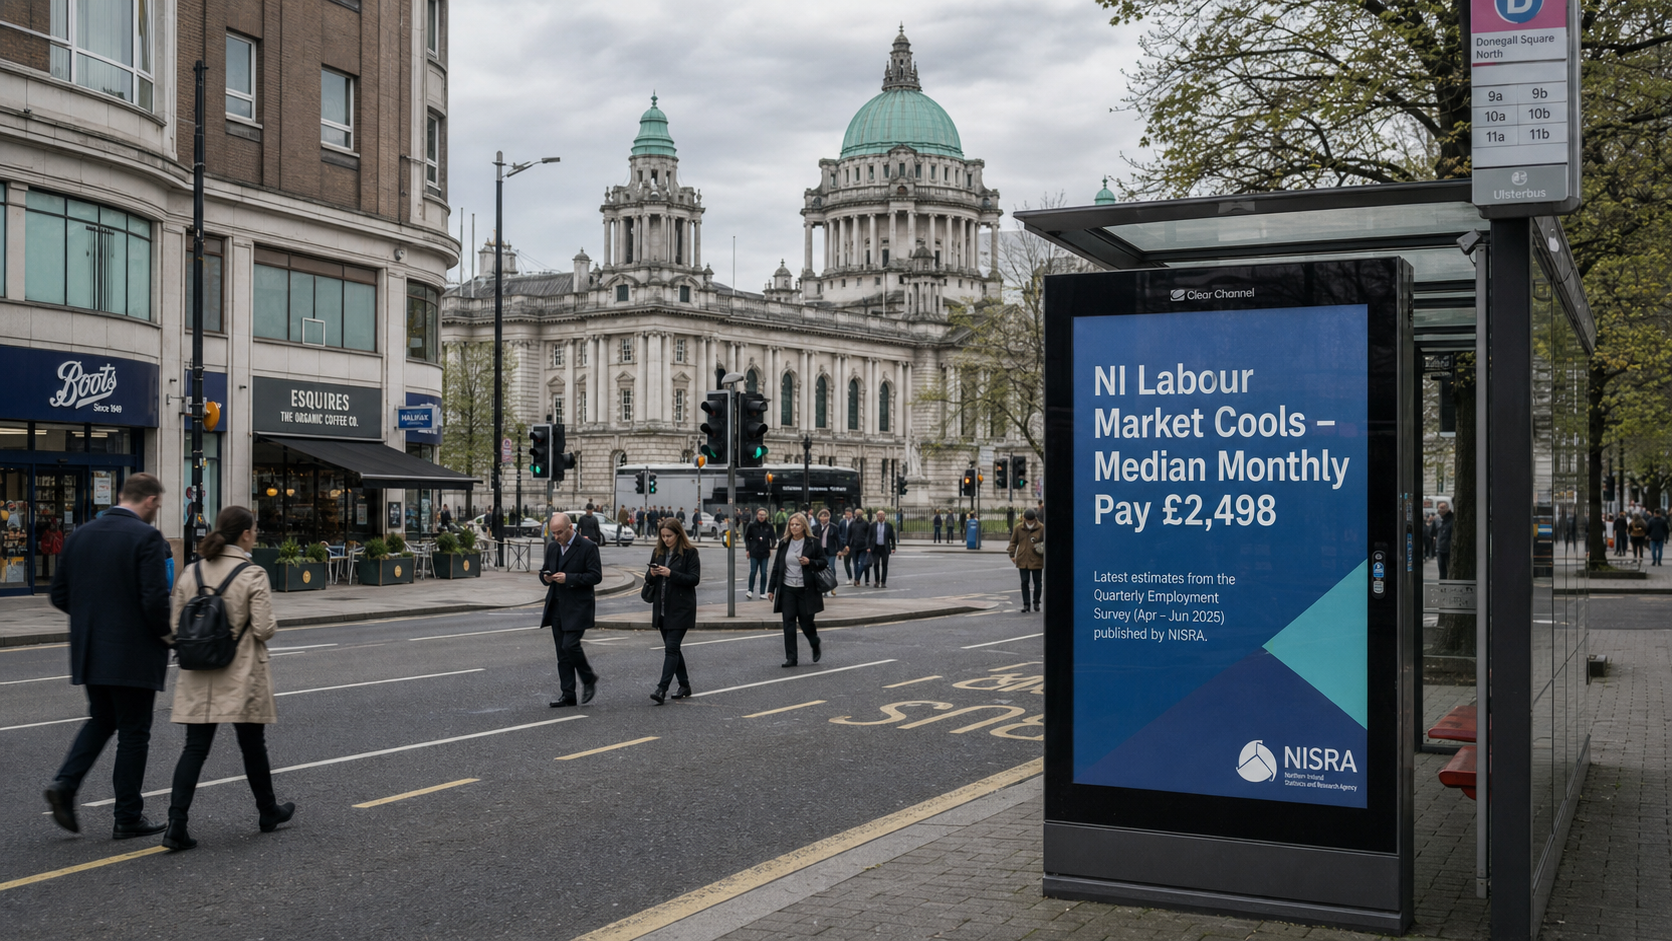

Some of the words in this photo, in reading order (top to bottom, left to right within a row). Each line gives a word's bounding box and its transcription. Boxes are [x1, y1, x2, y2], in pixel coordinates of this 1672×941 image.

[1476, 35, 1518, 48] Donegall
[1520, 34, 1555, 45] Square
[1476, 49, 1503, 59] North
[1488, 90, 1503, 102] 9a
[1532, 88, 1548, 99] 9b
[1485, 111, 1506, 122] 10a
[1529, 108, 1550, 119] 10b
[1486, 131, 1505, 142] 11a
[1529, 129, 1550, 140] 11b
[1493, 188, 1546, 200] Ulsterbus
[1187, 290, 1213, 300] Clear
[1214, 287, 1255, 299] Channel
[49, 360, 118, 410] Boots
[1094, 365, 1126, 396] NI
[1138, 363, 1254, 395] Labour
[291, 389, 350, 412] ESQUIRES
[280, 411, 294, 423] THE
[294, 412, 324, 425] ORGANIC
[324, 414, 348, 427] COFFEE
[348, 416, 359, 427] CO.
[1094, 407, 1204, 438] Market
[1214, 405, 1306, 438] Cools
[1094, 450, 1206, 482] Median
[1218, 449, 1350, 490] Monthly
[1094, 494, 1152, 533] Pay
[1162, 494, 1277, 531] £2,498
[1094, 571, 1128, 583] Latest
[1131, 572, 1184, 584] estimates
[1187, 572, 1214, 585] from
[1217, 573, 1236, 585] the
[1094, 589, 1144, 604] Quarterly
[1147, 590, 1219, 606] Employment
[1093, 607, 1131, 623] Survey
[1133, 608, 1157, 624] (Apr
[1168, 610, 1189, 622] Jun
[1192, 610, 1225, 625] 2025)
[1093, 627, 1147, 641] published
[1151, 628, 1165, 643] by
[1168, 629, 1208, 642] NISRA.
[1284, 745, 1358, 773] NISRA
